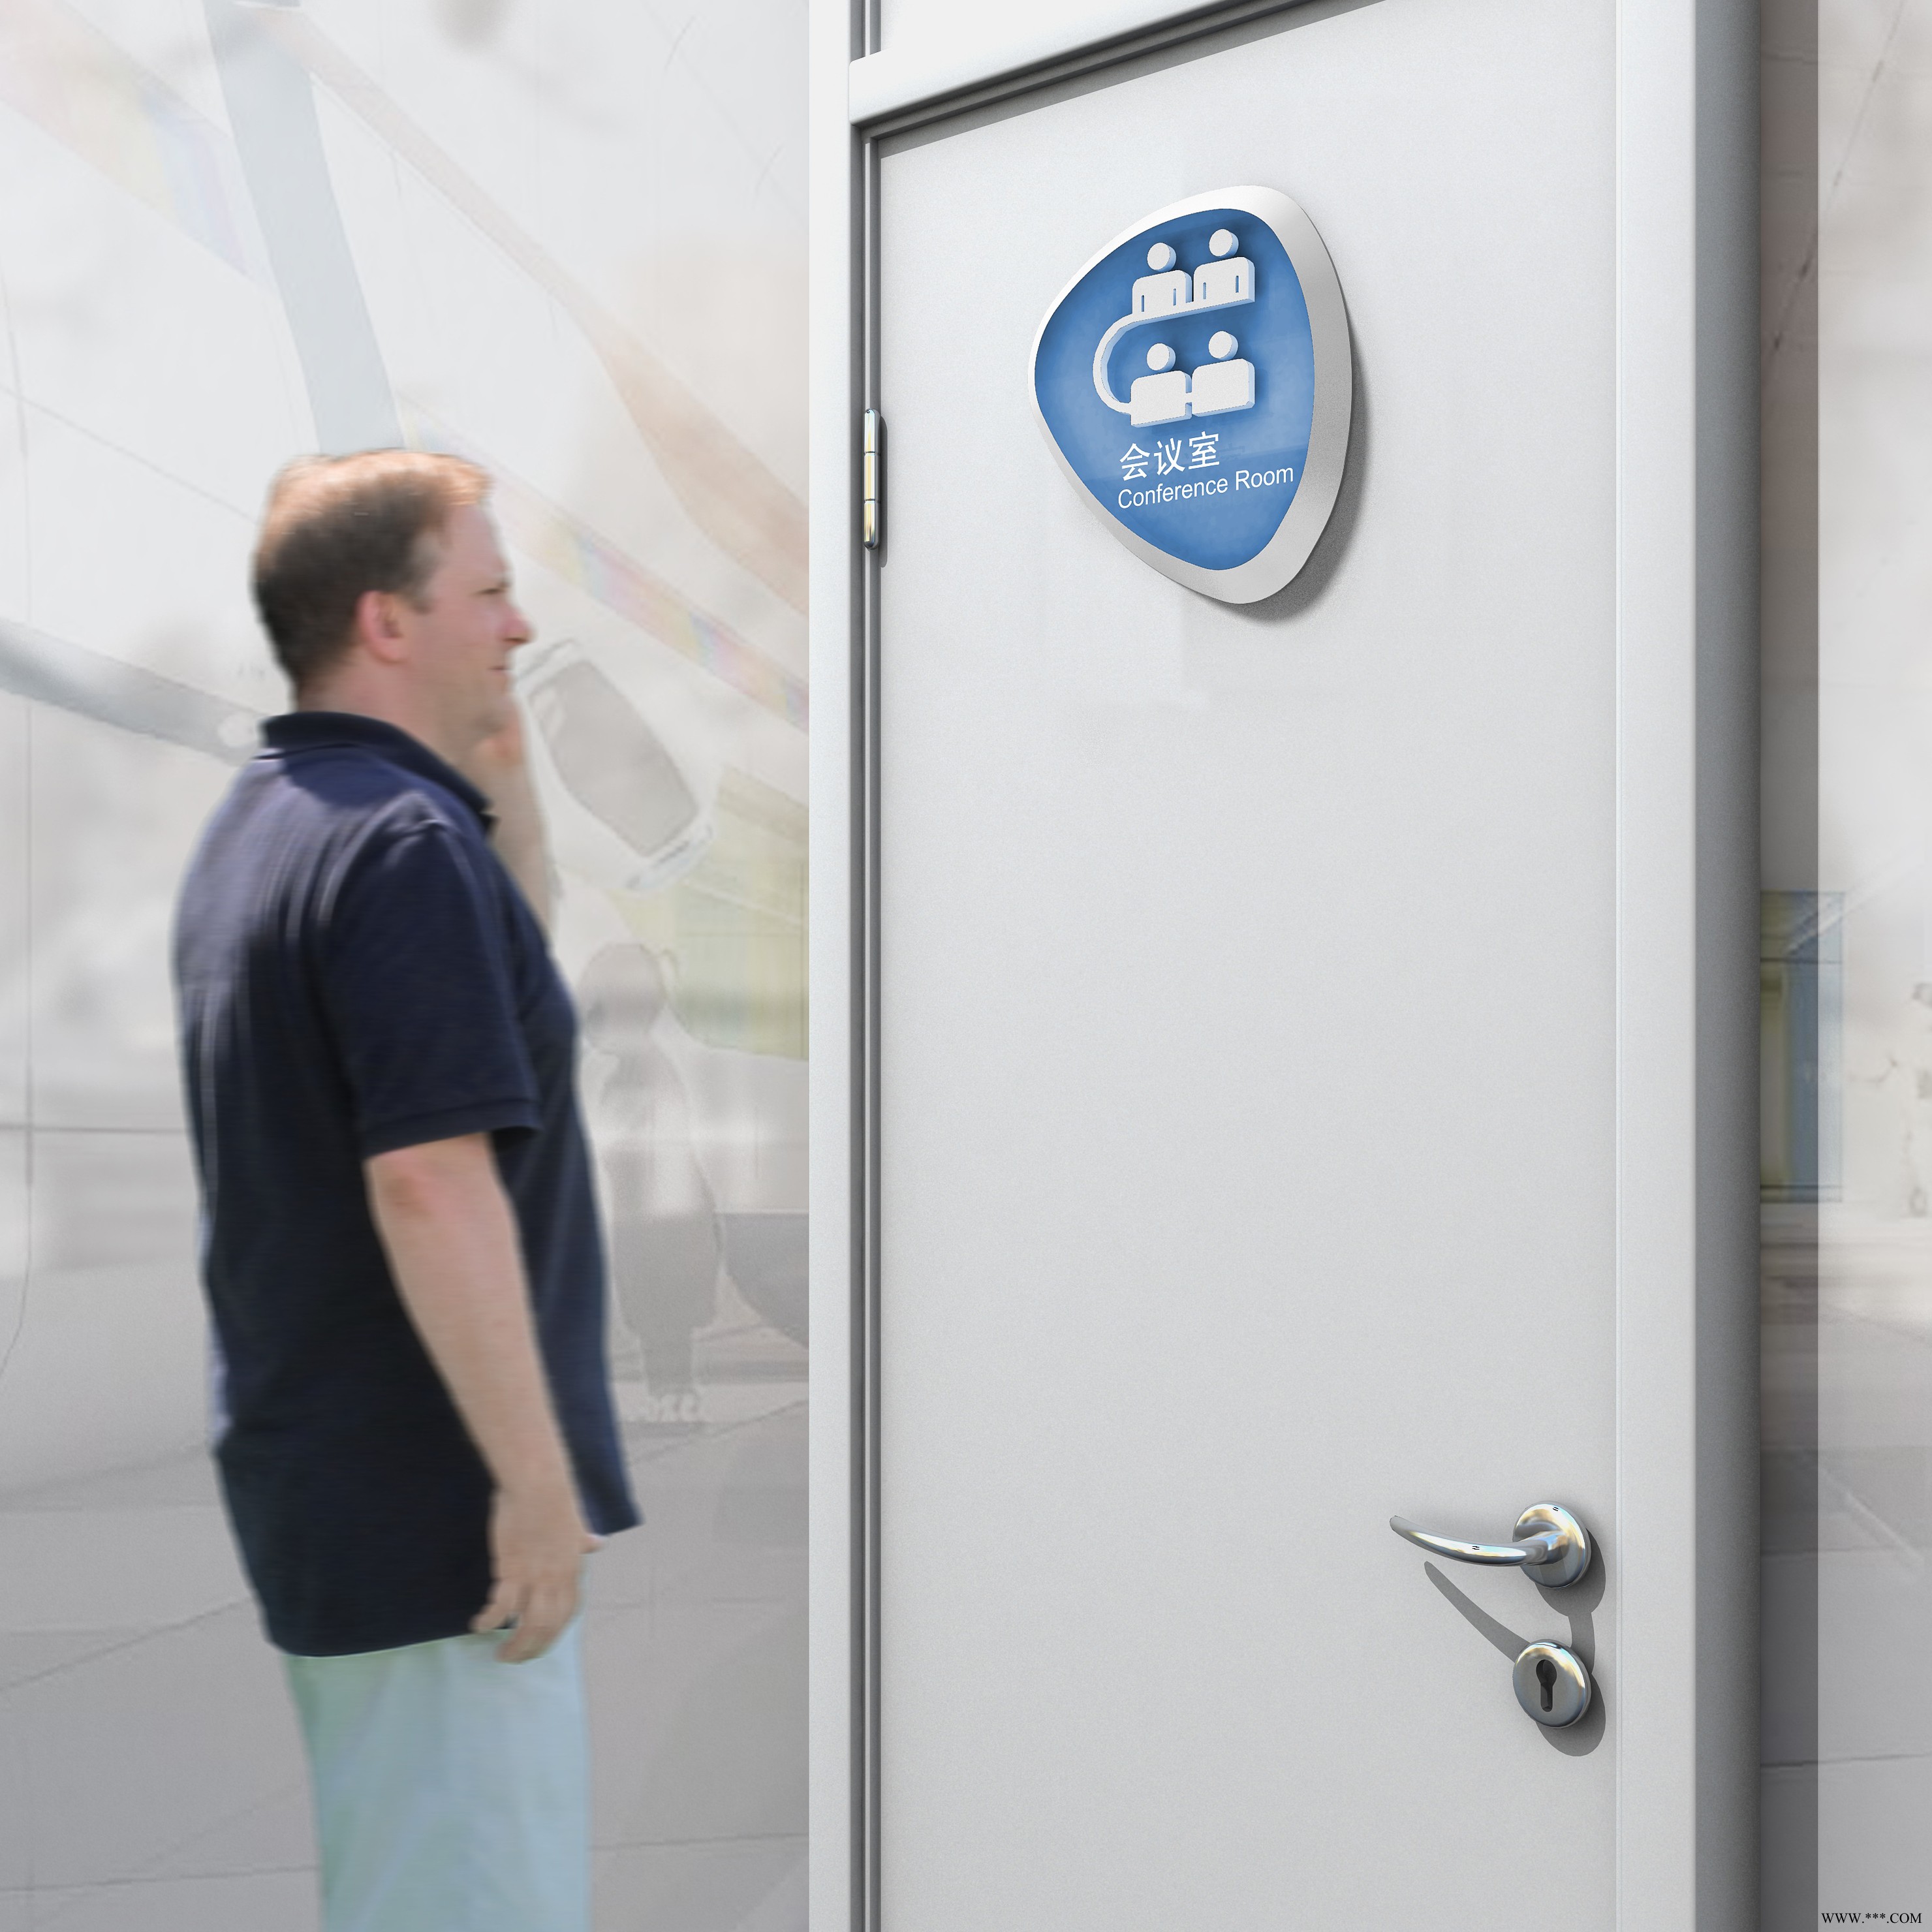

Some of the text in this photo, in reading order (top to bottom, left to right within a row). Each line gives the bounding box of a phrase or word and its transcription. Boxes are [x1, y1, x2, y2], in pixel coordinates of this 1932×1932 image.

[1119, 431, 1220, 481] 会议室
[1117, 467, 1294, 509] Conference Room
